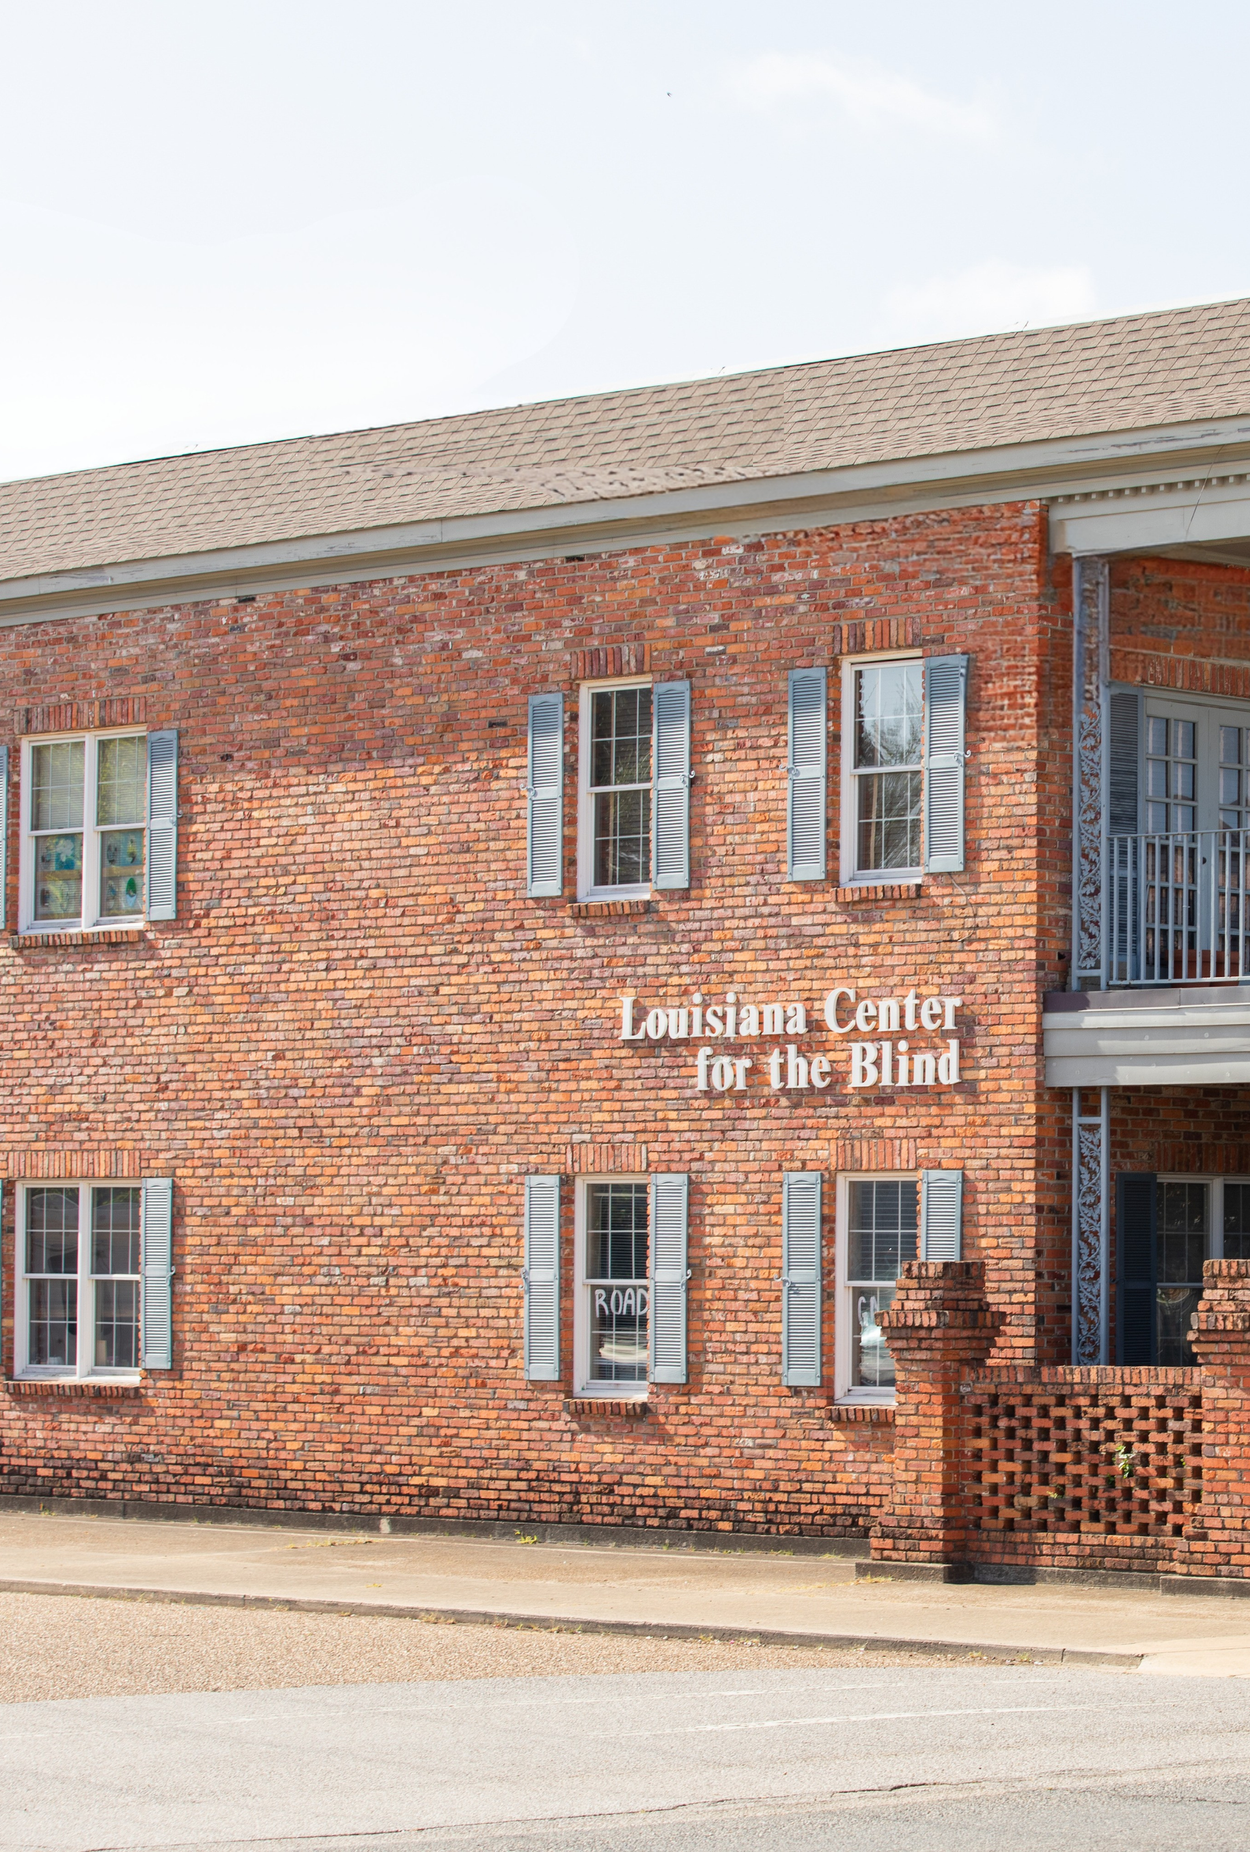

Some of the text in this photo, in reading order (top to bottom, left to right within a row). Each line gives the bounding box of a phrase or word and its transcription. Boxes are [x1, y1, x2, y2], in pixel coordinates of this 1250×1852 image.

[618, 987, 963, 1041] Louisiana Center
[694, 1039, 963, 1092] for the Blind
[594, 1287, 649, 1318] ROAD
